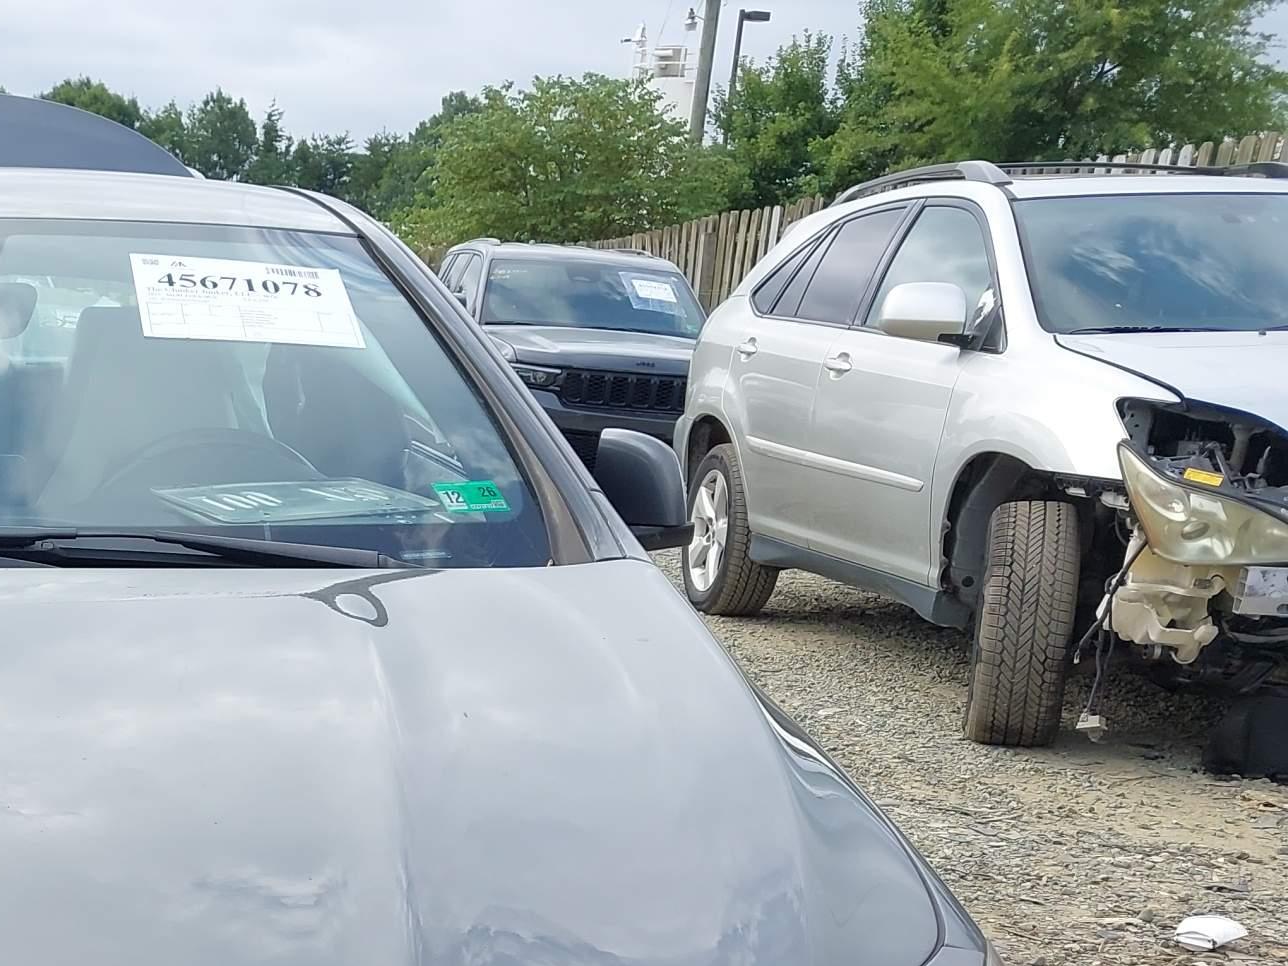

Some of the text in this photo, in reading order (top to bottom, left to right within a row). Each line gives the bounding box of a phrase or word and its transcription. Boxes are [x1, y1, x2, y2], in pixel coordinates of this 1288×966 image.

[158, 273, 322, 298] 45671078
[442, 486, 497, 504] 12 26
